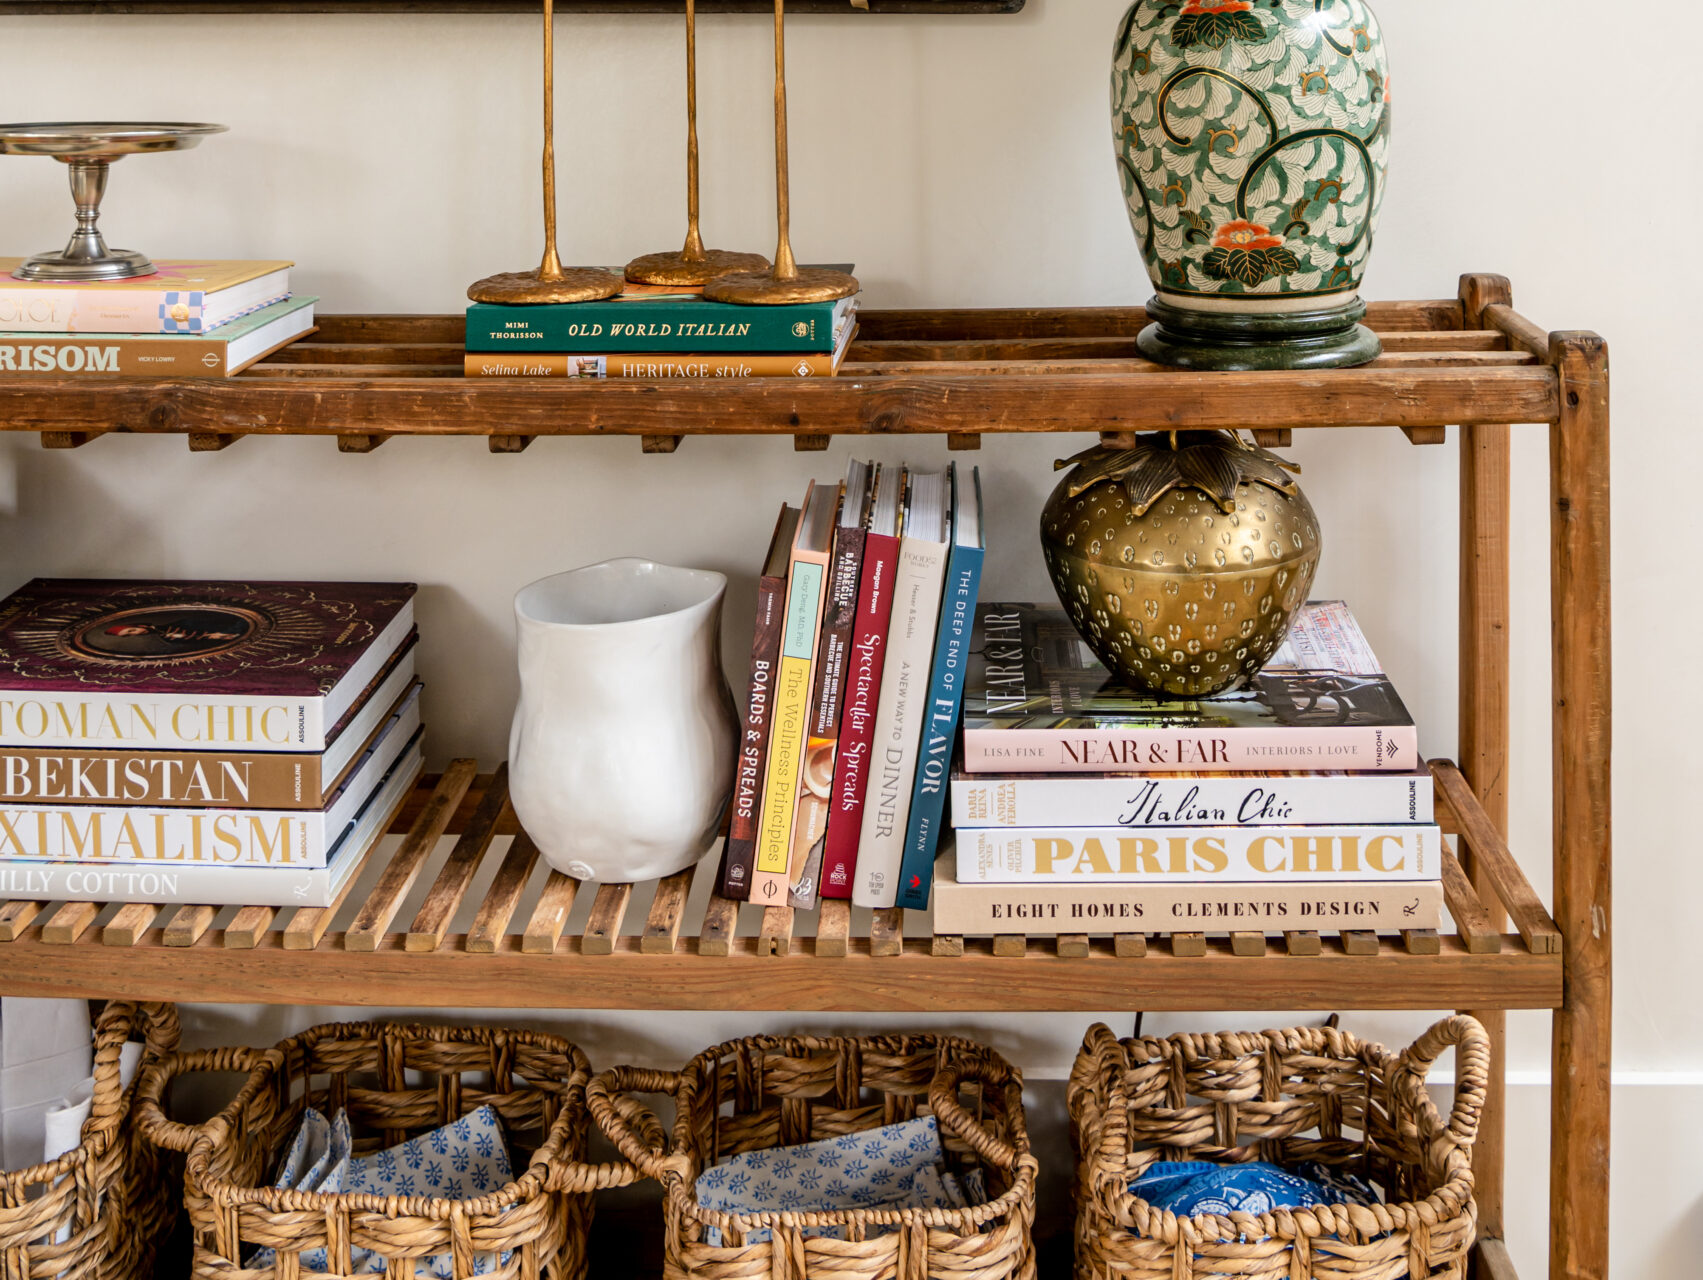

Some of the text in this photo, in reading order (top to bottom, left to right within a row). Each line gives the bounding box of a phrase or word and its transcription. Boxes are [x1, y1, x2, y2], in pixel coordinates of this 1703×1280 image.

[568, 323, 752, 337] OLD WORLD ITALIAN
[0, 344, 121, 372] RISOM
[481, 363, 552, 376] Selina Lake
[622, 363, 752, 378] HERITAGE style
[833, 555, 846, 602] AND GRILLING
[838, 552, 854, 607] BARBECUE
[870, 590, 880, 614] Brown
[921, 569, 972, 795] THE DEEP END OF FLAVOR
[983, 611, 1028, 715] NEAR & FAR
[817, 633, 838, 734] BARBECUE AND SOUTHERN ESSENTIALS
[825, 641, 844, 728] THE ULTIMATE GUIDE TO PERFECT
[1048, 680, 1064, 714] INTERIORS
[1068, 686, 1082, 703] LOVE
[171, 703, 290, 744] CHIC
[738, 660, 770, 819] BOARDS & SPREADS
[842, 633, 881, 812] Spectacular Spreads
[768, 669, 803, 862] The Wellness Principles
[875, 661, 910, 840] A NEW WAY TO DINNER
[984, 747, 1010, 757] LISA
[1017, 747, 1045, 757] FINE
[1060, 739, 1142, 764] NEAR
[1148, 741, 1168, 764] &
[1176, 739, 1231, 763] FAR
[1246, 746, 1313, 756] INTERIORS
[1327, 745, 1358, 755] LOVE
[1375, 729, 1383, 767] VENDOME
[2, 755, 253, 803] BEKISTAN
[294, 763, 302, 802] ASSOULINE
[968, 788, 977, 819] DARIA
[978, 788, 987, 819] REINA
[997, 783, 1006, 824] ANDREA
[1007, 782, 1016, 825] FEROLLA
[1118, 780, 1293, 825] Italian Chic
[1408, 780, 1416, 821] ASSOULINE
[0, 809, 297, 864] XIMALISM
[917, 817, 930, 852] FLYNN
[1032, 835, 1405, 874] PARIS CHIC
[1007, 841, 1015, 871] OLIVER
[66, 871, 179, 896] COTTON
[992, 901, 1381, 918] EIGHT HOMES CLEMENTS DESIGN
